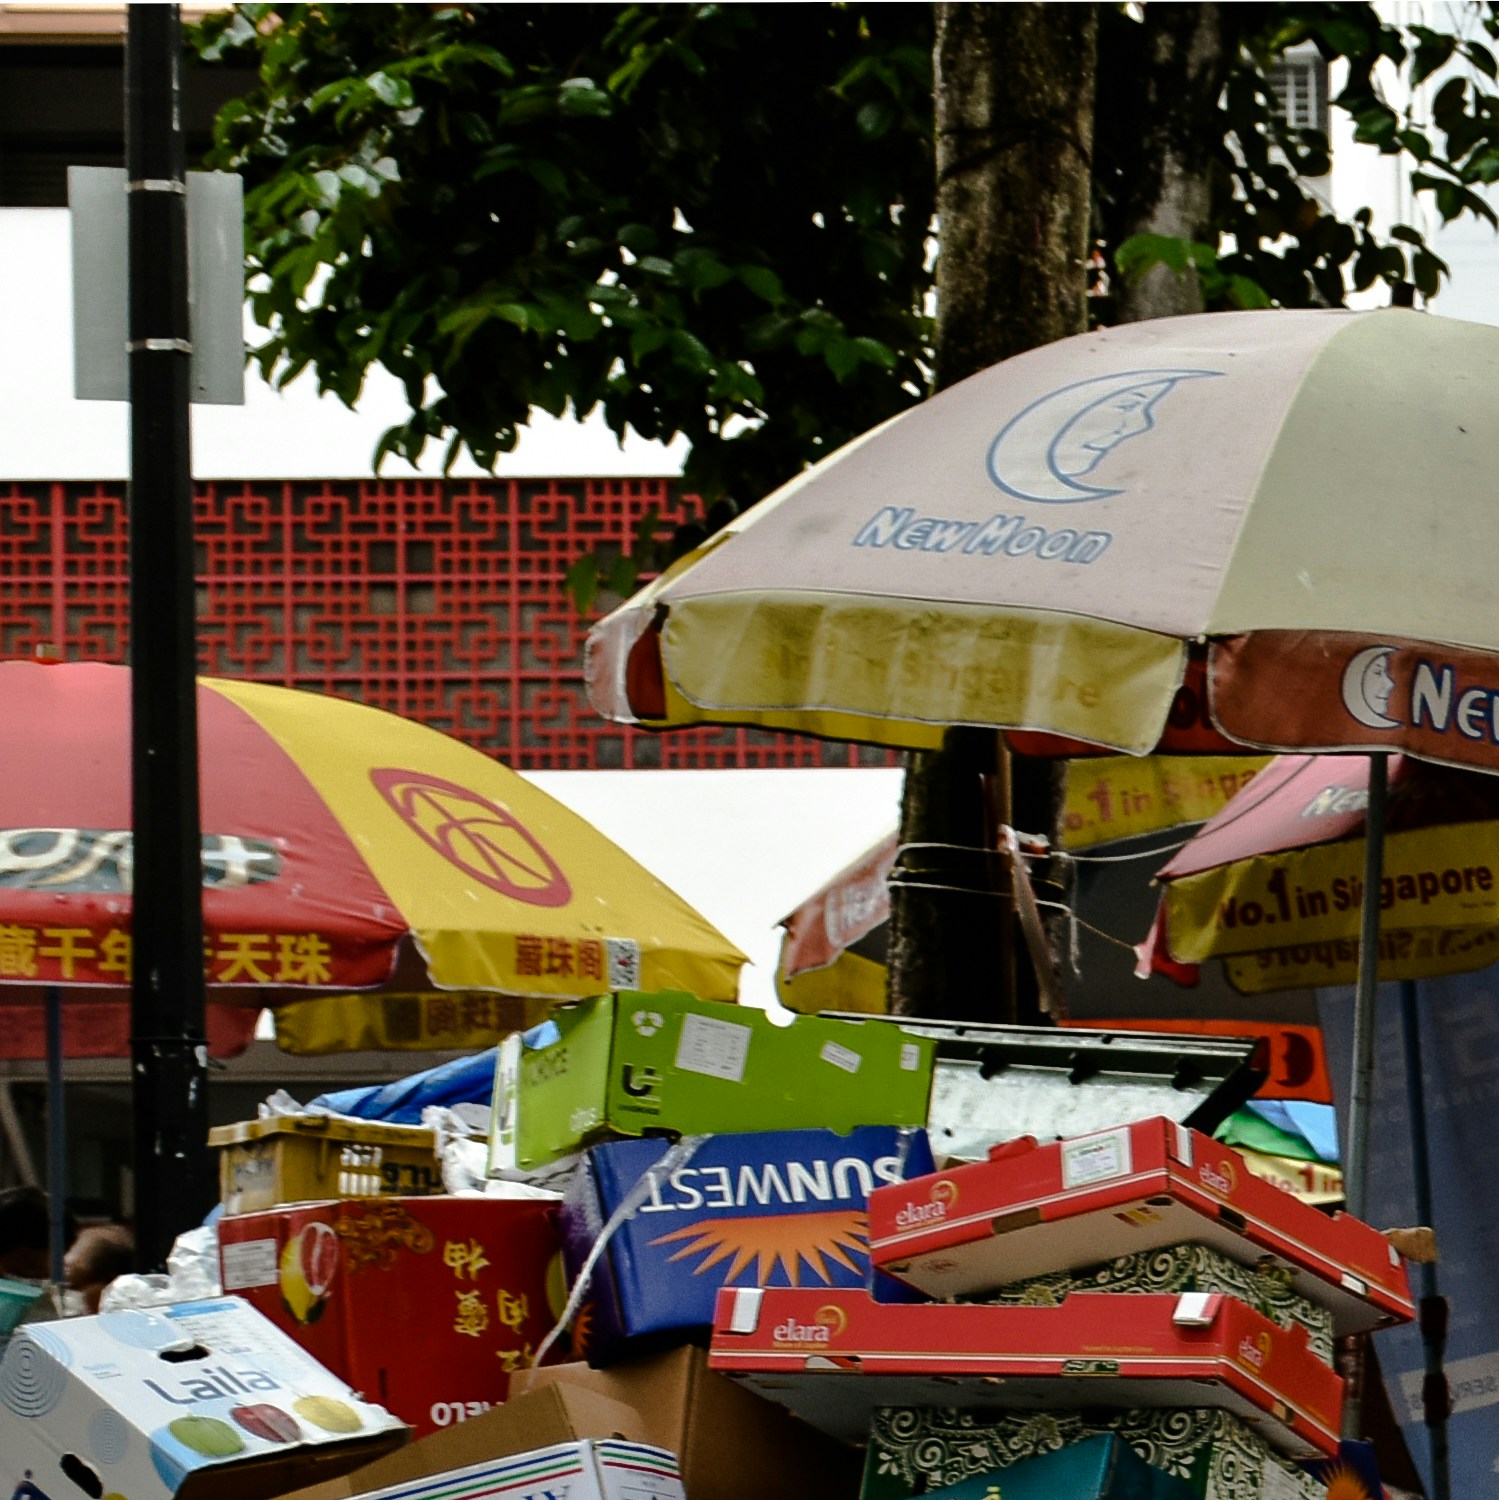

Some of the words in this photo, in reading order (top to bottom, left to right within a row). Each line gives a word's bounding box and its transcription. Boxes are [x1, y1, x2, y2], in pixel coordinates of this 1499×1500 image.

[1296, 886, 1328, 920] in
[1333, 863, 1495, 914] Sigapore
[639, 1156, 904, 1214] SUNWEST
[895, 1200, 946, 1226] elara
[772, 1317, 831, 1342] elara
[143, 1365, 281, 1405] Laila
